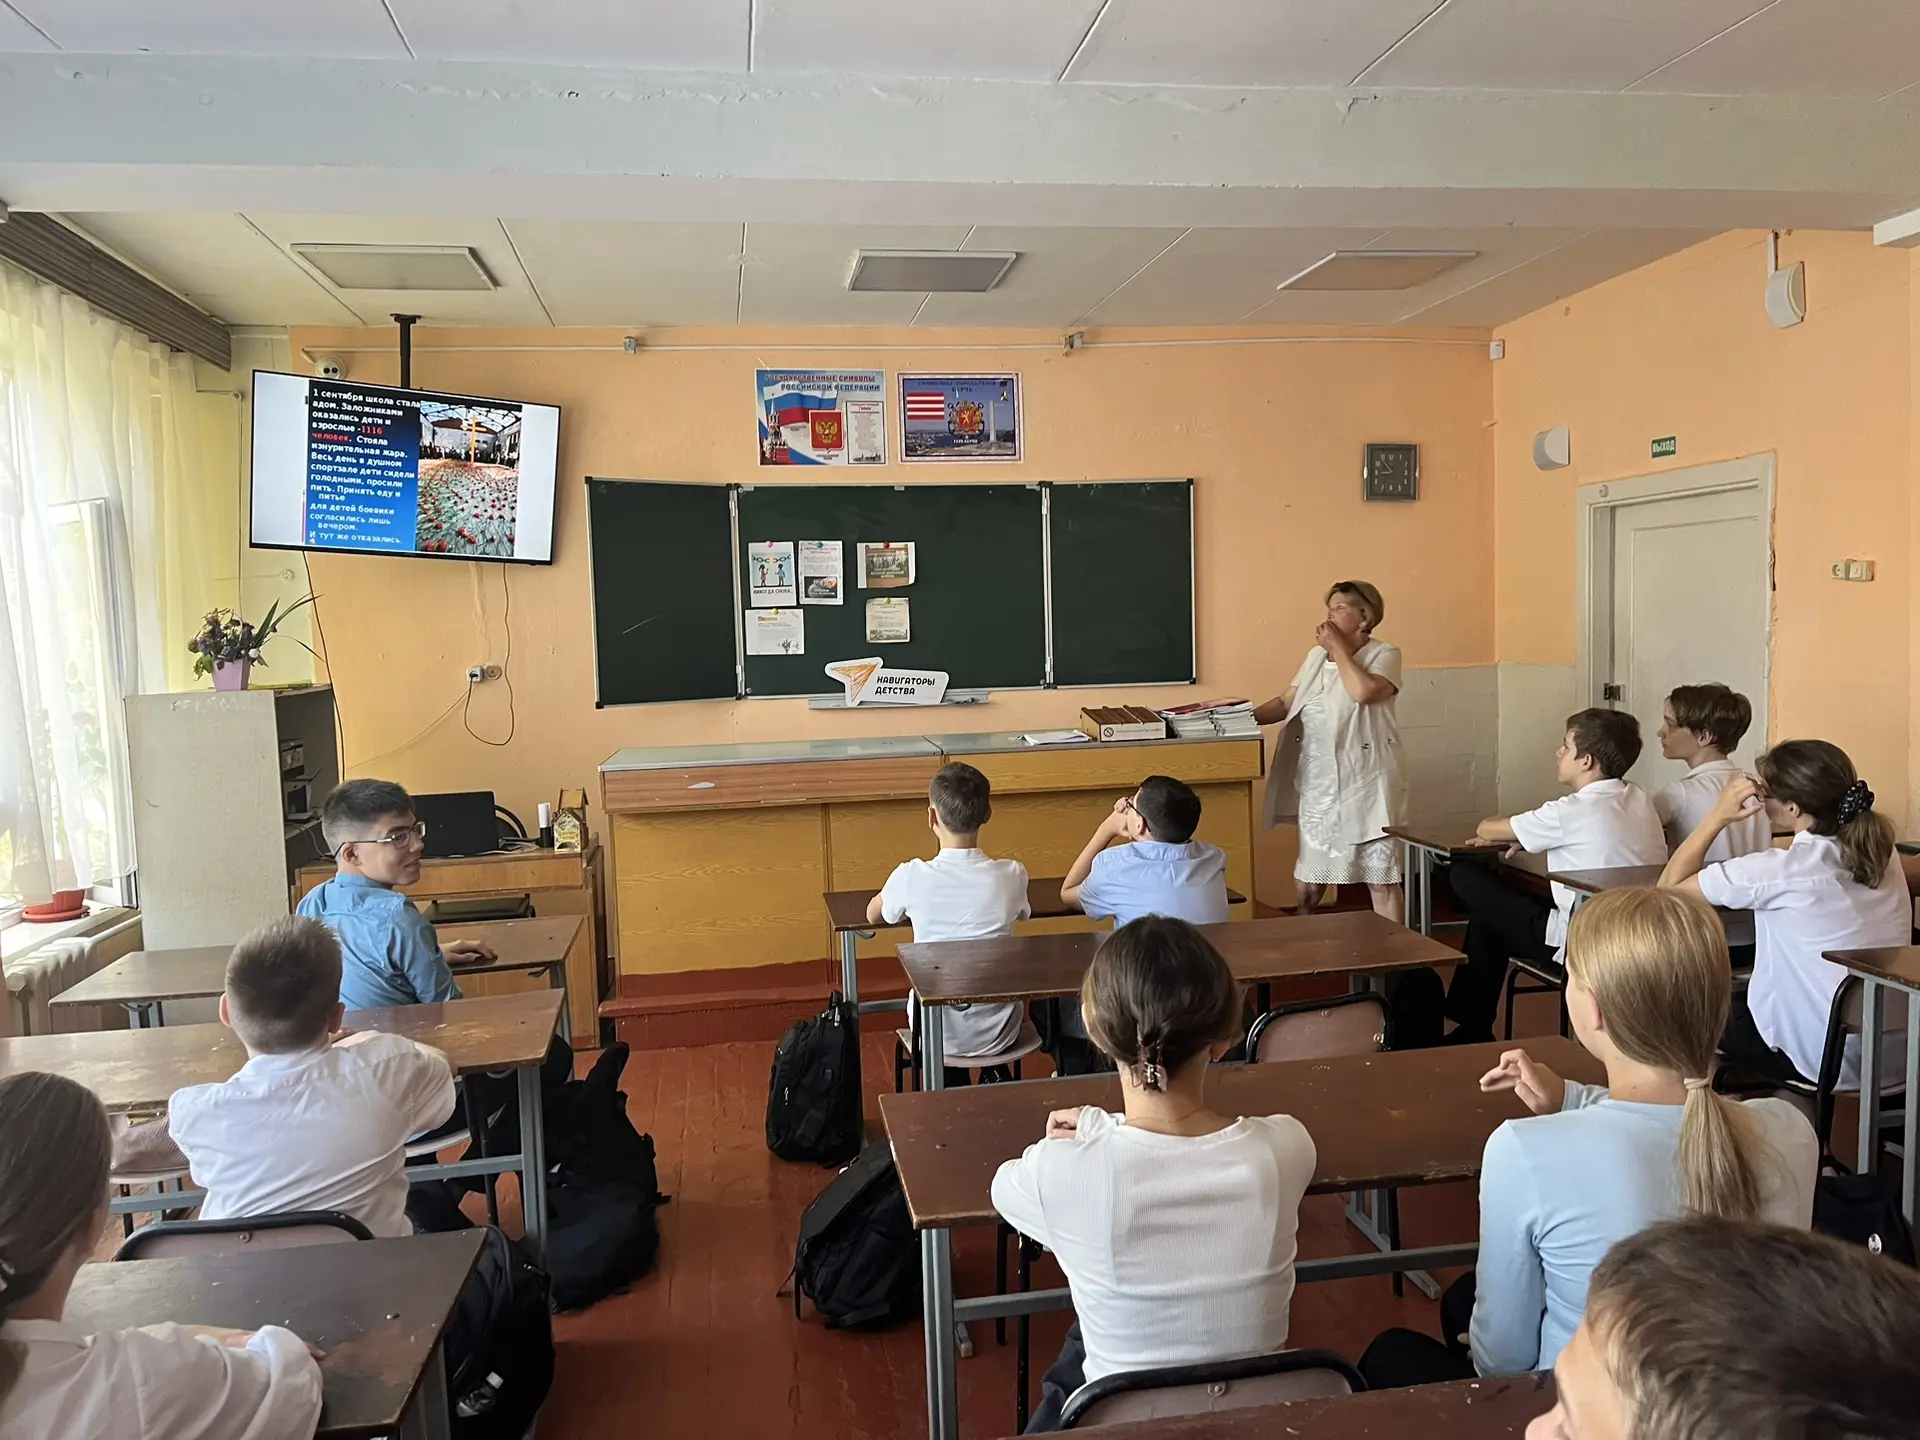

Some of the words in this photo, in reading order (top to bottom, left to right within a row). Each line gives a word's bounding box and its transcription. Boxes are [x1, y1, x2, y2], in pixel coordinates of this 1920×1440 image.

[834, 384, 880, 392] ФЕДЕРАЦИИ
[321, 390, 363, 402] сентября
[365, 396, 394, 405] школа
[396, 399, 421, 408] стала
[312, 400, 339, 410] адом.
[341, 402, 403, 416] Заложниками
[312, 411, 359, 422] оказались
[362, 417, 383, 425] дети
[312, 422, 355, 432] взрослые
[313, 433, 352, 442] человек.
[356, 435, 388, 446] Стояла
[312, 443, 380, 455] изнурительная
[382, 450, 408, 458] жара.
[1653, 440, 1674, 453] ВЫХОД
[311, 452, 333, 461] Весь
[335, 455, 357, 463] день
[366, 459, 402, 468] душном
[311, 463, 358, 474] спортзале
[360, 468, 382, 476] дети
[384, 470, 415, 478] сидели
[310, 474, 364, 485] голодными,
[366, 479, 403, 488] просили
[310, 484, 335, 492] пить.
[337, 486, 375, 495] Принять
[318, 493, 345, 501] питье
[330, 504, 356, 512] детей
[358, 505, 395, 515] боевики
[310, 514, 365, 523] согласились
[368, 517, 391, 525] лишь
[318, 522, 358, 532] вечером.
[309, 530, 316, 538] И
[319, 532, 334, 540] тут
[351, 535, 403, 544] отказались.
[876, 676, 936, 686] НАВИГАТОРЫ
[875, 687, 915, 695] ДЕТСТВА
